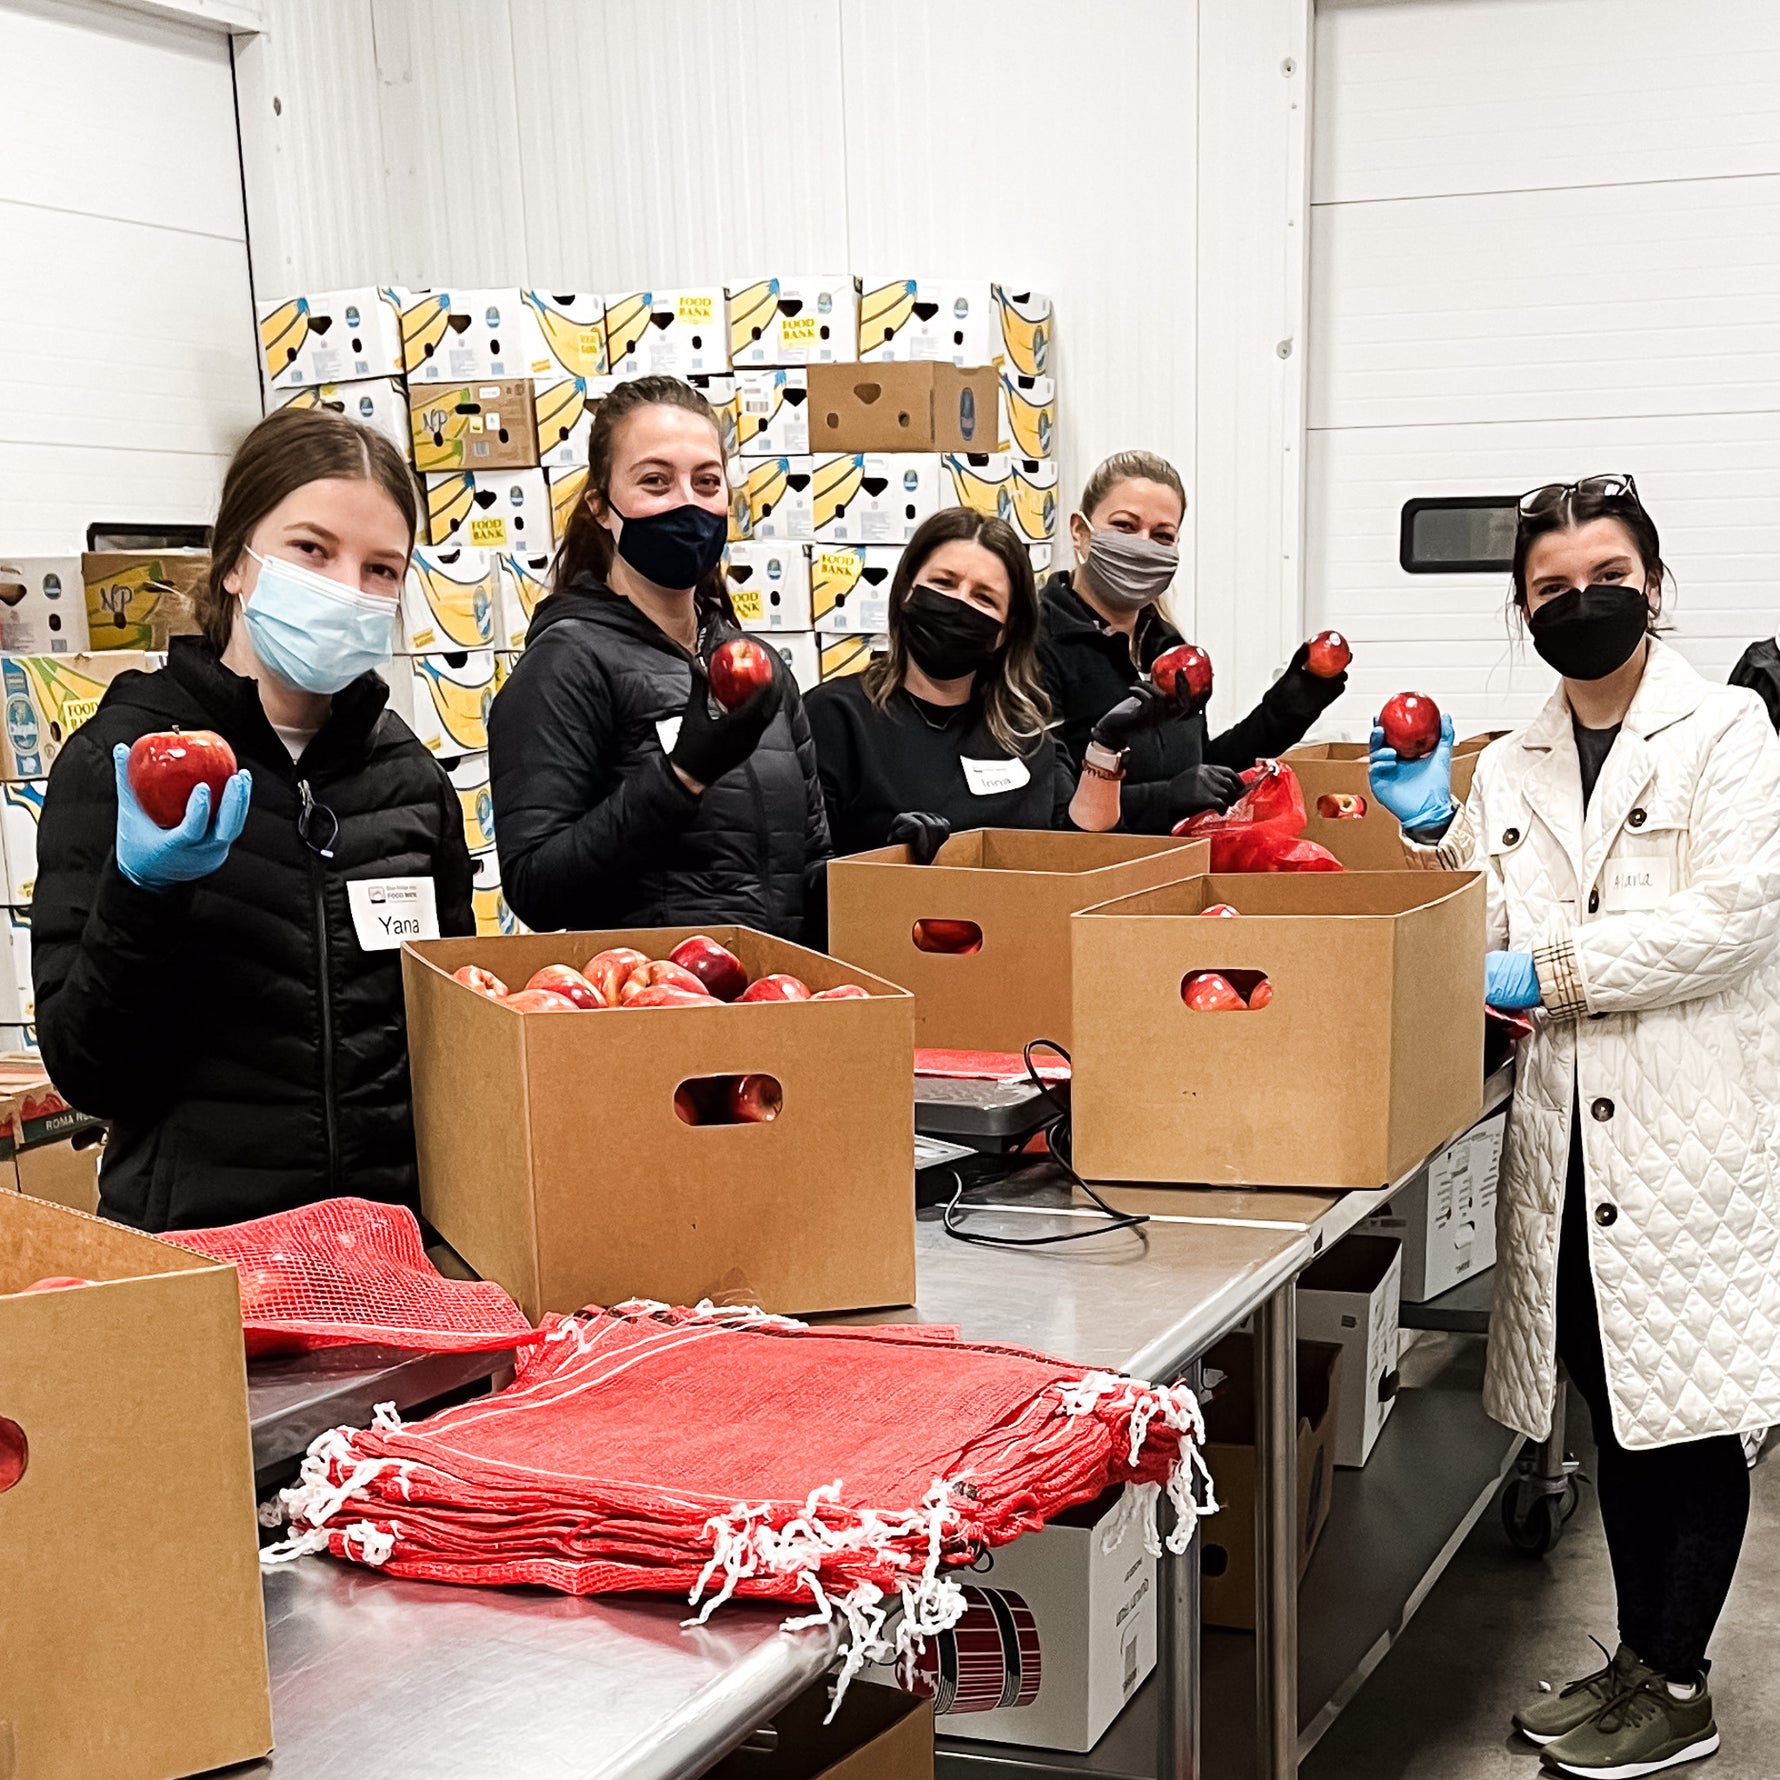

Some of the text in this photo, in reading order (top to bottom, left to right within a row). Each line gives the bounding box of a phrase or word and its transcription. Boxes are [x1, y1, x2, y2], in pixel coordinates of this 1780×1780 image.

[679, 297, 711, 307] FOOD
[679, 307, 711, 317] BANK
[782, 318, 815, 329] FOOD
[783, 329, 815, 340] BANK
[472, 519, 502, 530] FOOD
[473, 529, 504, 540] BANK
[821, 553, 855, 565] FOOD
[821, 564, 853, 576] BANK
[732, 591, 759, 602] OOD
[736, 601, 760, 613] ANK
[378, 915, 420, 935] Yana
[45, 1114, 75, 1131] ROMA
